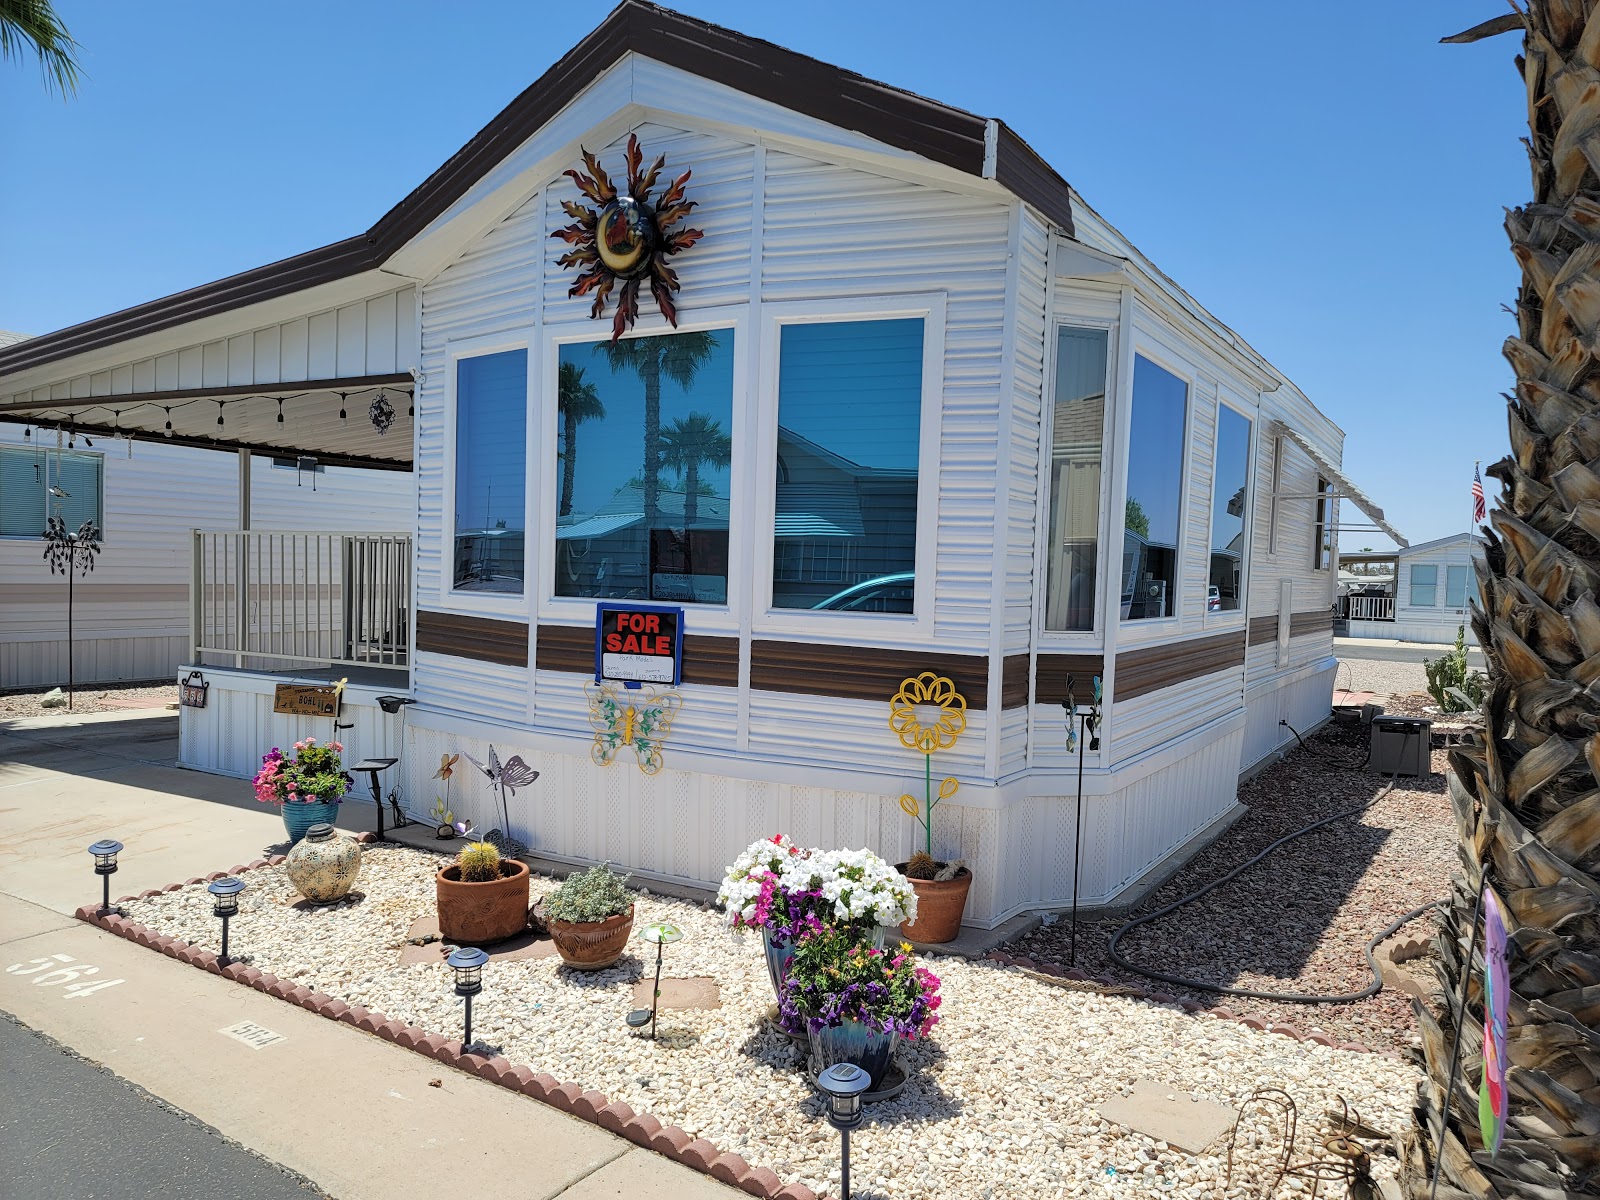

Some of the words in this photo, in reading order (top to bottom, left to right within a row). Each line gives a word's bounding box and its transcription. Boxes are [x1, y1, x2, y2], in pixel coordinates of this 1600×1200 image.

[617, 614, 660, 633] FOR
[606, 633, 671, 655] SALE
[5, 953, 127, 1000] 564
[231, 1024, 281, 1046] 564
